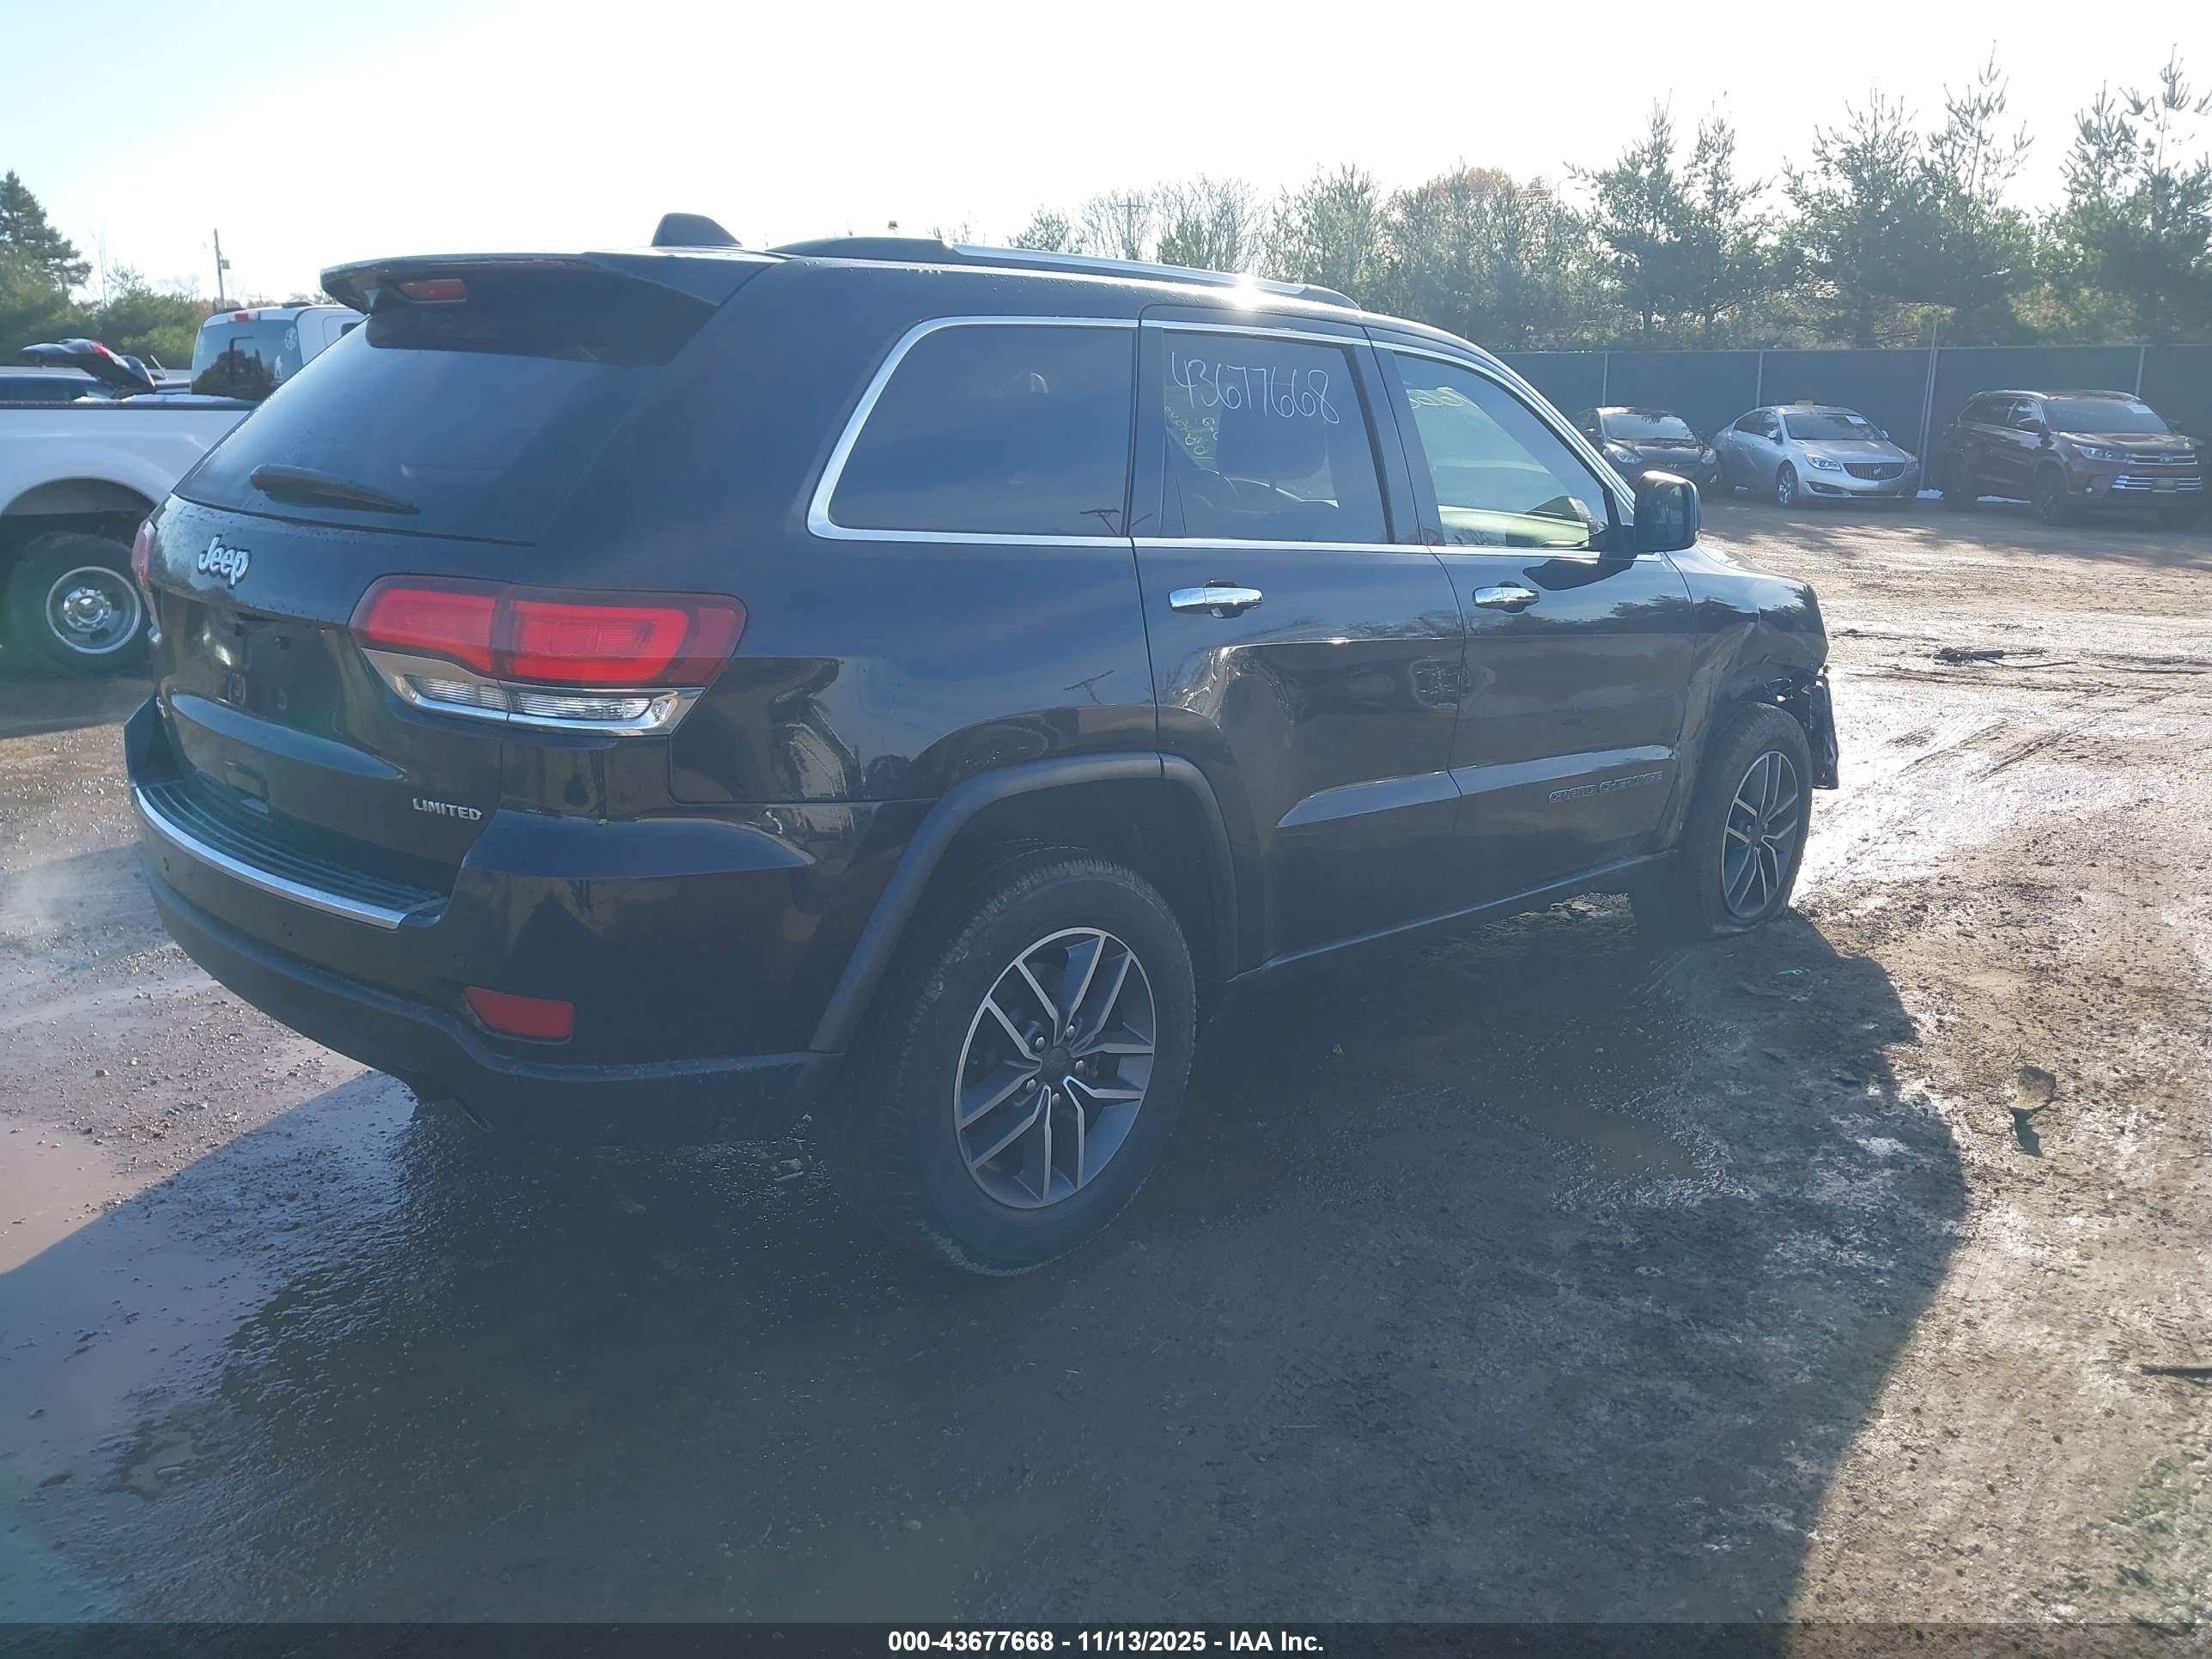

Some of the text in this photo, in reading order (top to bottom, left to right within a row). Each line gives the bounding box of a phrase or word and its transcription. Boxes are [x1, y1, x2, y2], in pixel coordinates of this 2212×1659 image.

[1170, 350, 1340, 425] 43677668
[198, 535, 250, 586] Jeep
[412, 797, 482, 821] LIMITED
[1548, 783, 1596, 805] GRAND
